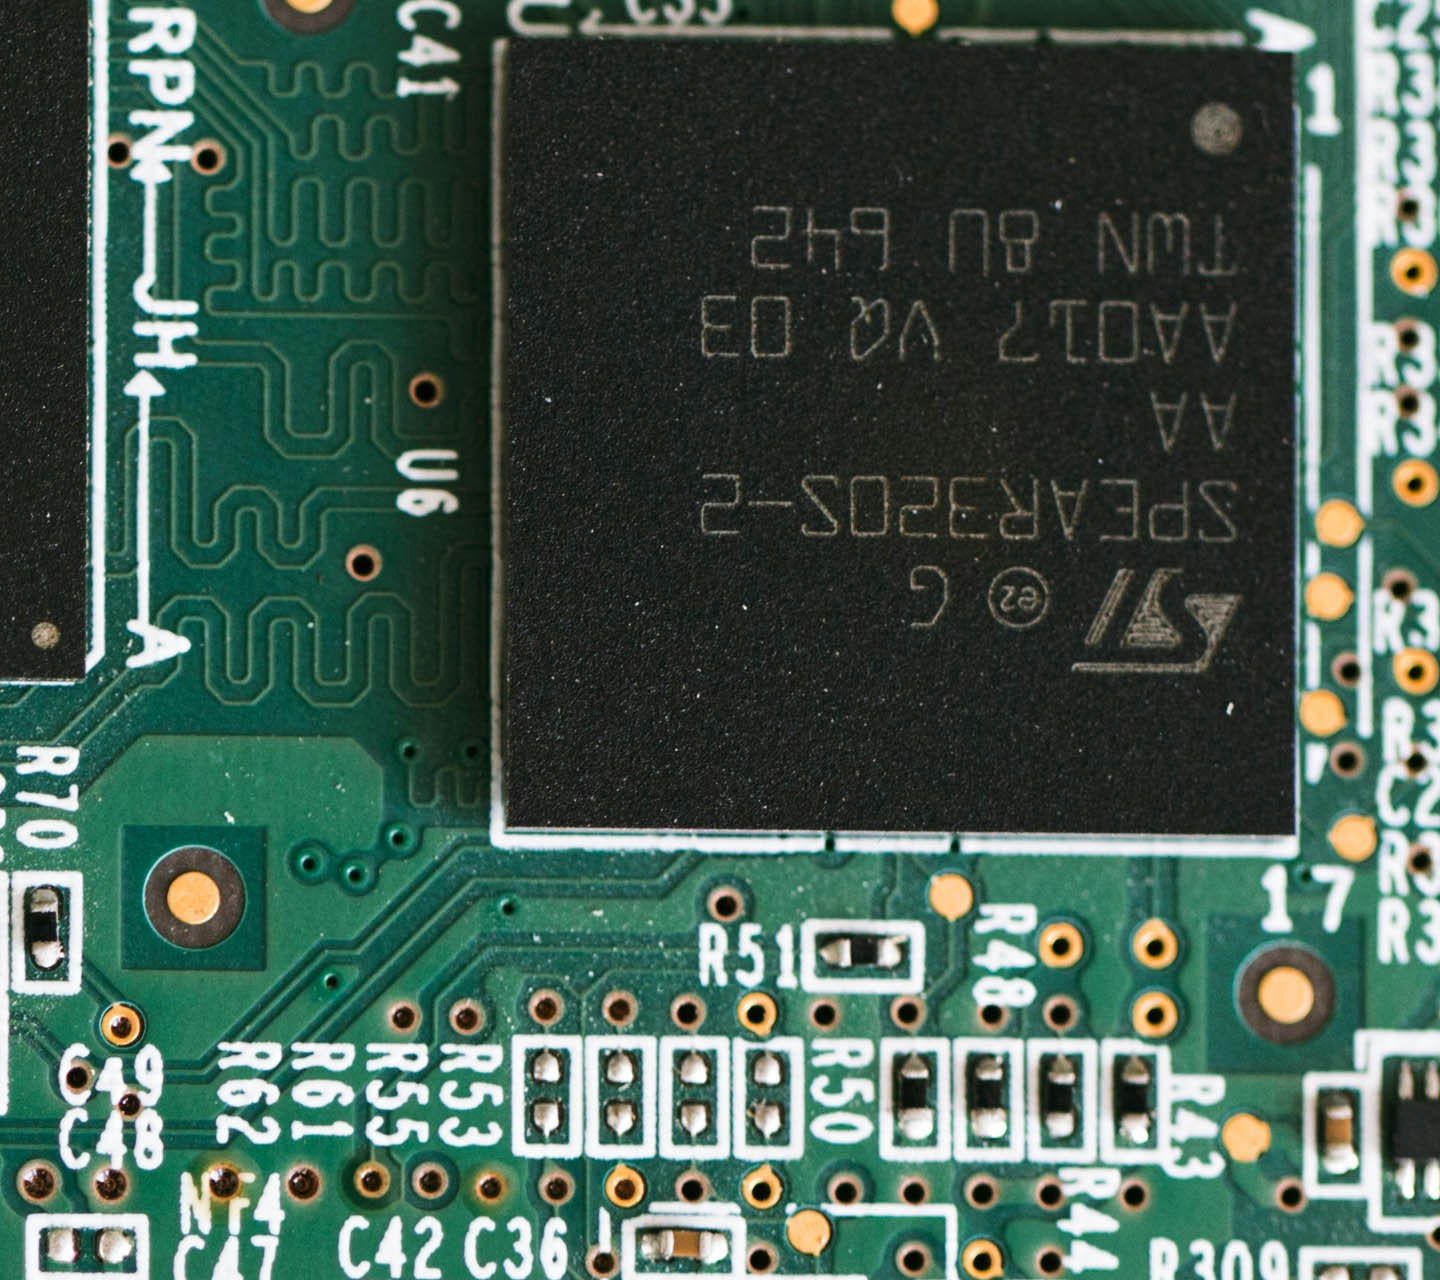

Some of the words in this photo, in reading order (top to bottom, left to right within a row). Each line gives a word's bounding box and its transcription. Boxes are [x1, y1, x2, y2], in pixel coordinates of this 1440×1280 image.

[397, 0, 460, 97] C41
[751, 206, 890, 271] 642
[1098, 213, 1237, 275] TWN
[999, 300, 1237, 364] AA017
[1152, 394, 1237, 451] AA
[397, 450, 459, 516] U6
[701, 473, 1238, 542] SPEAR320S-2
[16, 745, 80, 849] R70
[1260, 865, 1355, 932] 17
[699, 923, 797, 988] R51
[973, 904, 1037, 1007] R48
[216, 1042, 280, 1143] R62
[290, 1042, 355, 1139] R61
[364, 1042, 428, 1146] R55
[437, 1042, 503, 1146] R53
[810, 1038, 875, 1144] R50
[59, 1106, 163, 1171] C48
[1169, 1075, 1225, 1178] R43
[339, 1216, 443, 1279] C42
[465, 1216, 569, 1279] C36
[1056, 1168, 1120, 1274] R44
